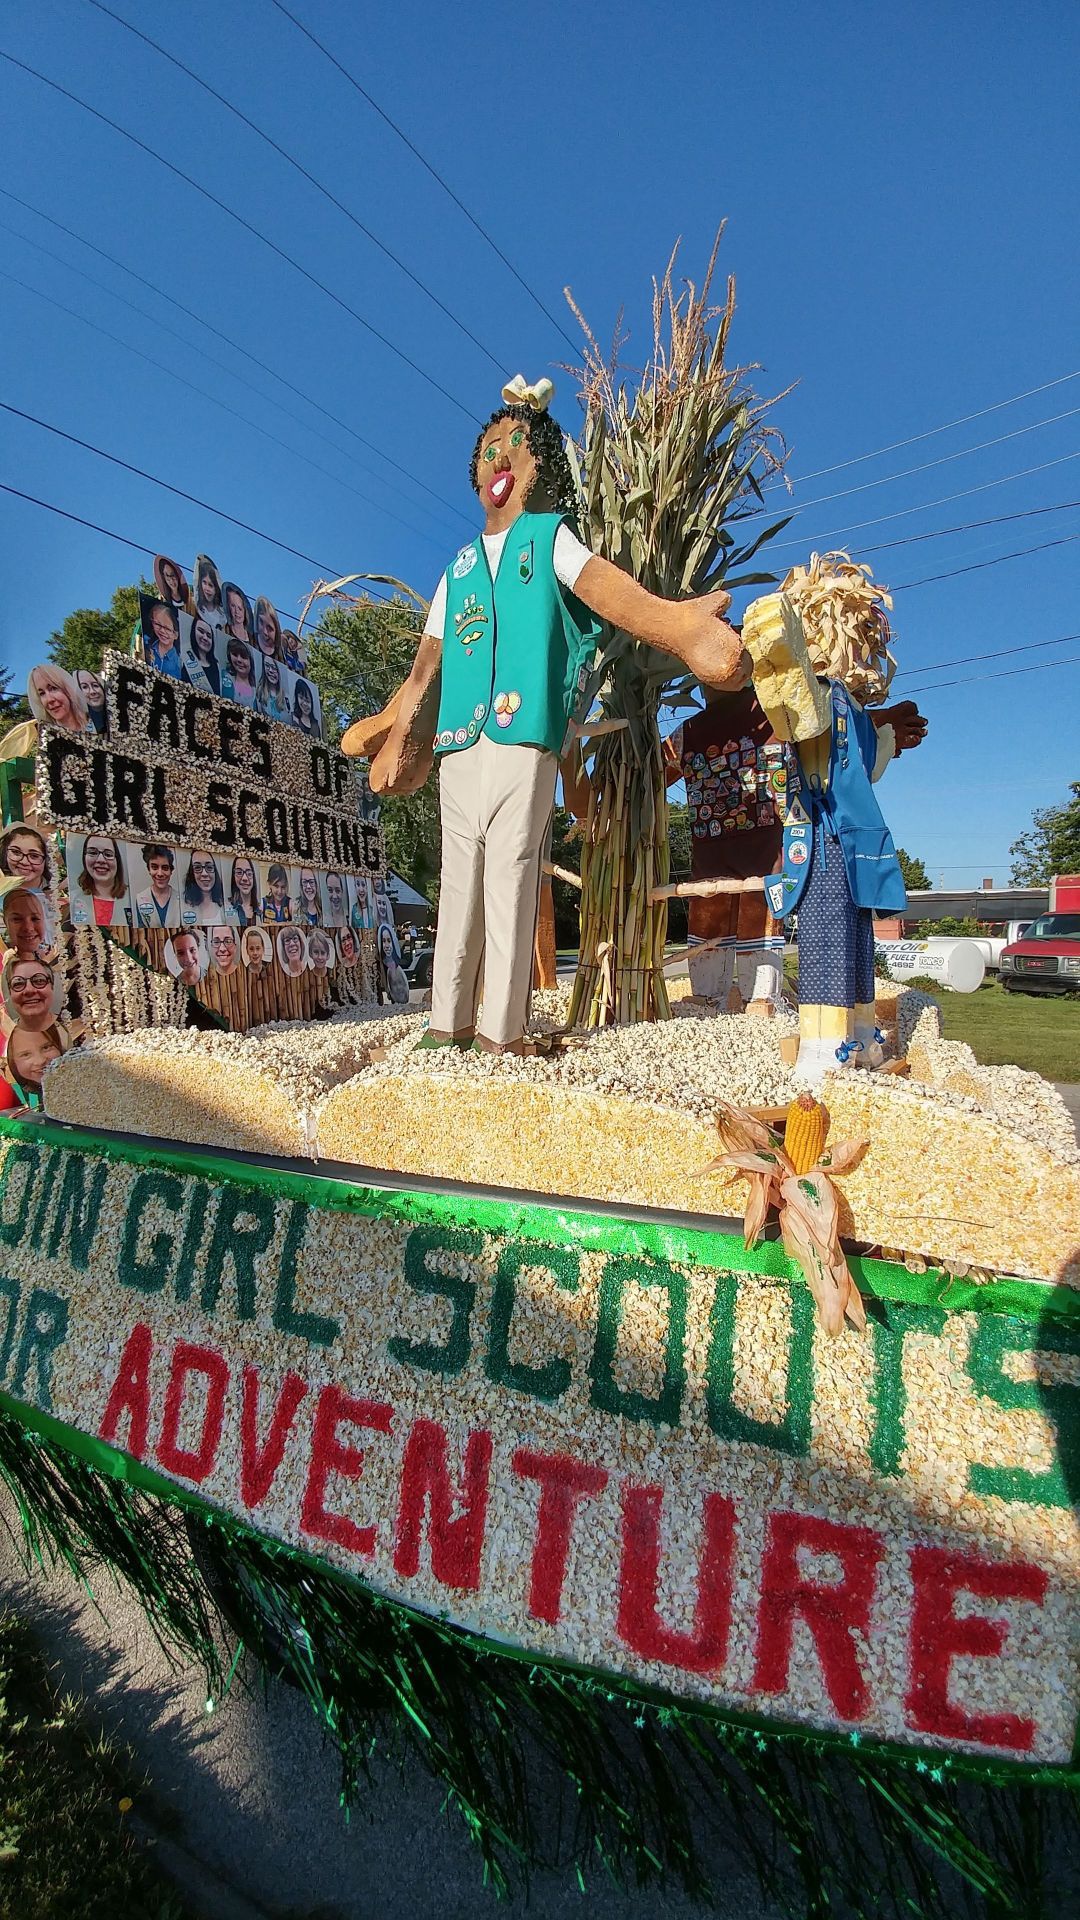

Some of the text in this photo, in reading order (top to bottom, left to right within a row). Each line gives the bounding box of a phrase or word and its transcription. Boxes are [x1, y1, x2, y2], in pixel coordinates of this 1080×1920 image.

[113, 666, 351, 797] FACES OF
[45, 736, 382, 873] GIRL SCOUTING
[890, 953, 917, 962] FUELS
[919, 956, 945, 967] TORCO
[117, 1169, 342, 1346] GIRL
[386, 1223, 1080, 1510] SCOUTS
[100, 1321, 1049, 1752] ADVENTURE
